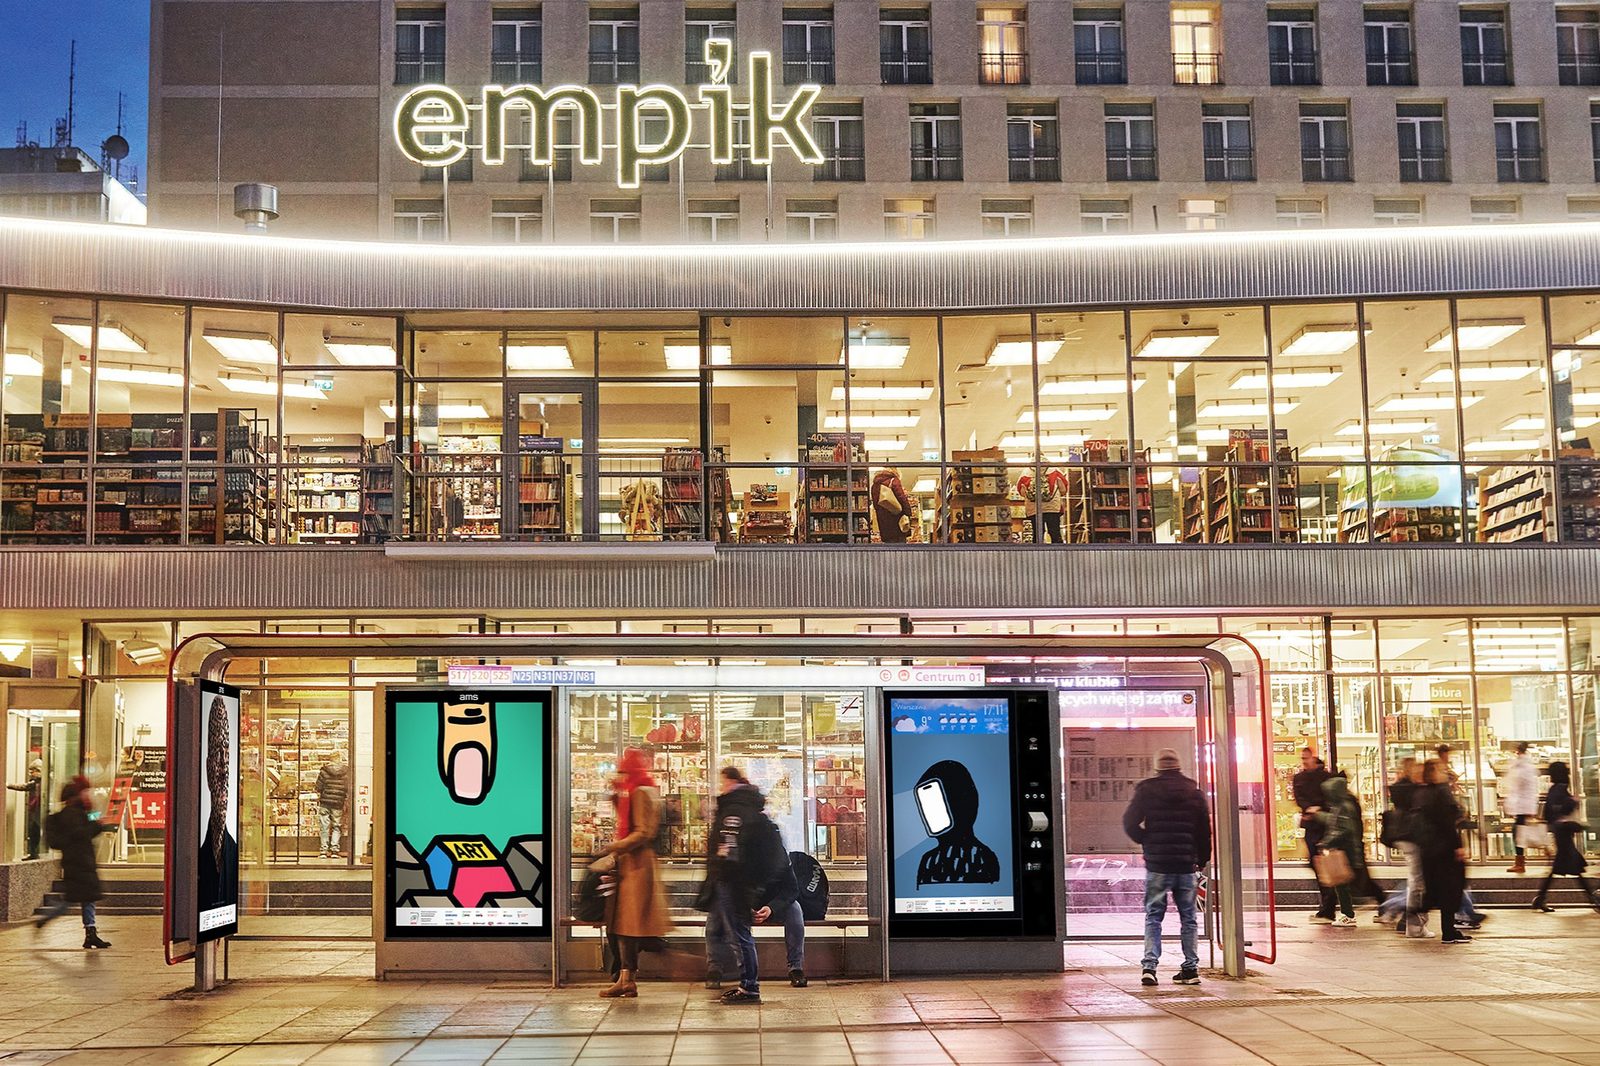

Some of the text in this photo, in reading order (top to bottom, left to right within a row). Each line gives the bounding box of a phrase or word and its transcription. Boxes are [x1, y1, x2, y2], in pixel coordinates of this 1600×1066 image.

[393, 38, 825, 189] empik
[166, 416, 184, 424] puzzl
[1085, 441, 1107, 450] -70%
[450, 671, 594, 681] 517 520 525 N25 N31 N37 N81
[915, 671, 966, 682] Centrum
[969, 672, 982, 682] 01
[459, 693, 479, 701] ams
[1431, 686, 1462, 698] biura
[453, 842, 490, 859] ART
